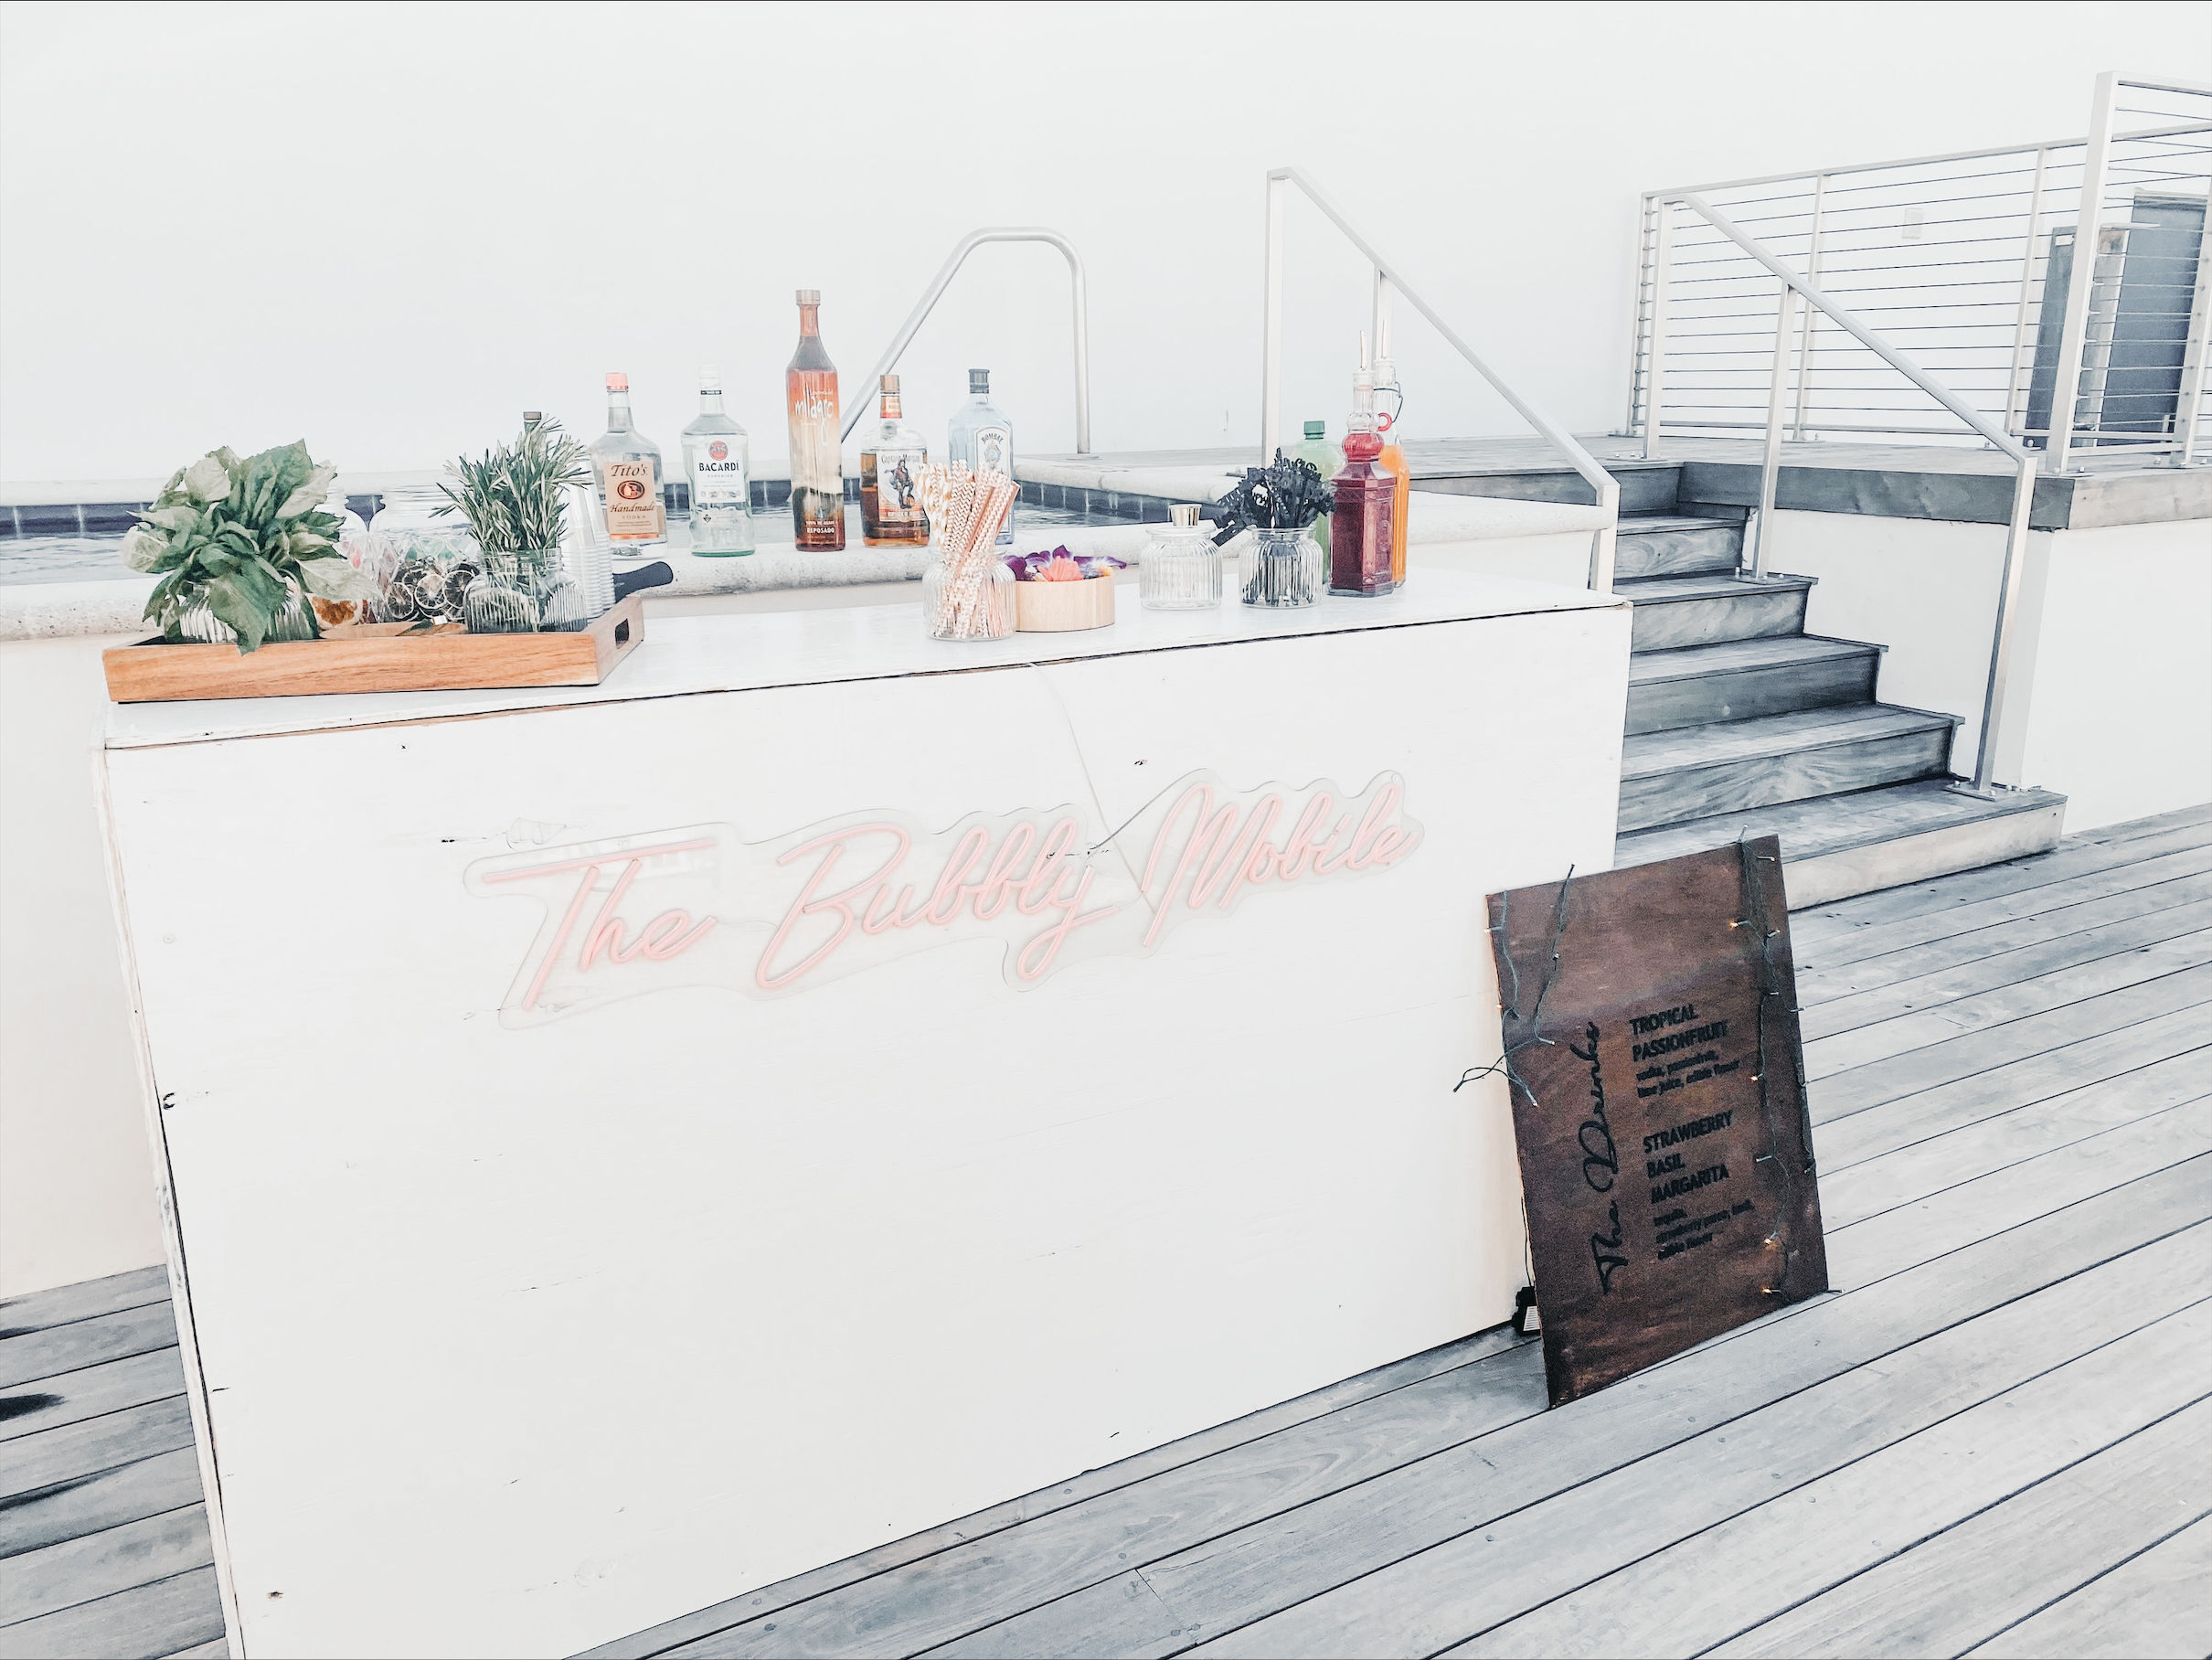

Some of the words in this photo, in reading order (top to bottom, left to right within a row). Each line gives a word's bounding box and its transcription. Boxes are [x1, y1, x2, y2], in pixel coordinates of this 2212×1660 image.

[981, 432, 1004, 445] BOMBAY
[611, 463, 648, 476] Tito's
[610, 501, 655, 513] Handmade
[482, 838, 718, 1012] The
[754, 817, 1122, 988] Bubbly
[1140, 782, 1418, 949] Mobile
[1629, 1004, 1699, 1036] TROPICAL
[1632, 1018, 1728, 1062] PASSIONFRUIT
[1570, 1021, 1619, 1193] Drinks
[1643, 1110, 1733, 1154] STRAWBERRY
[1646, 1153, 1686, 1179] BASIL
[1651, 1163, 1729, 1204] MARGARITA
[1591, 1199, 1629, 1295] The
